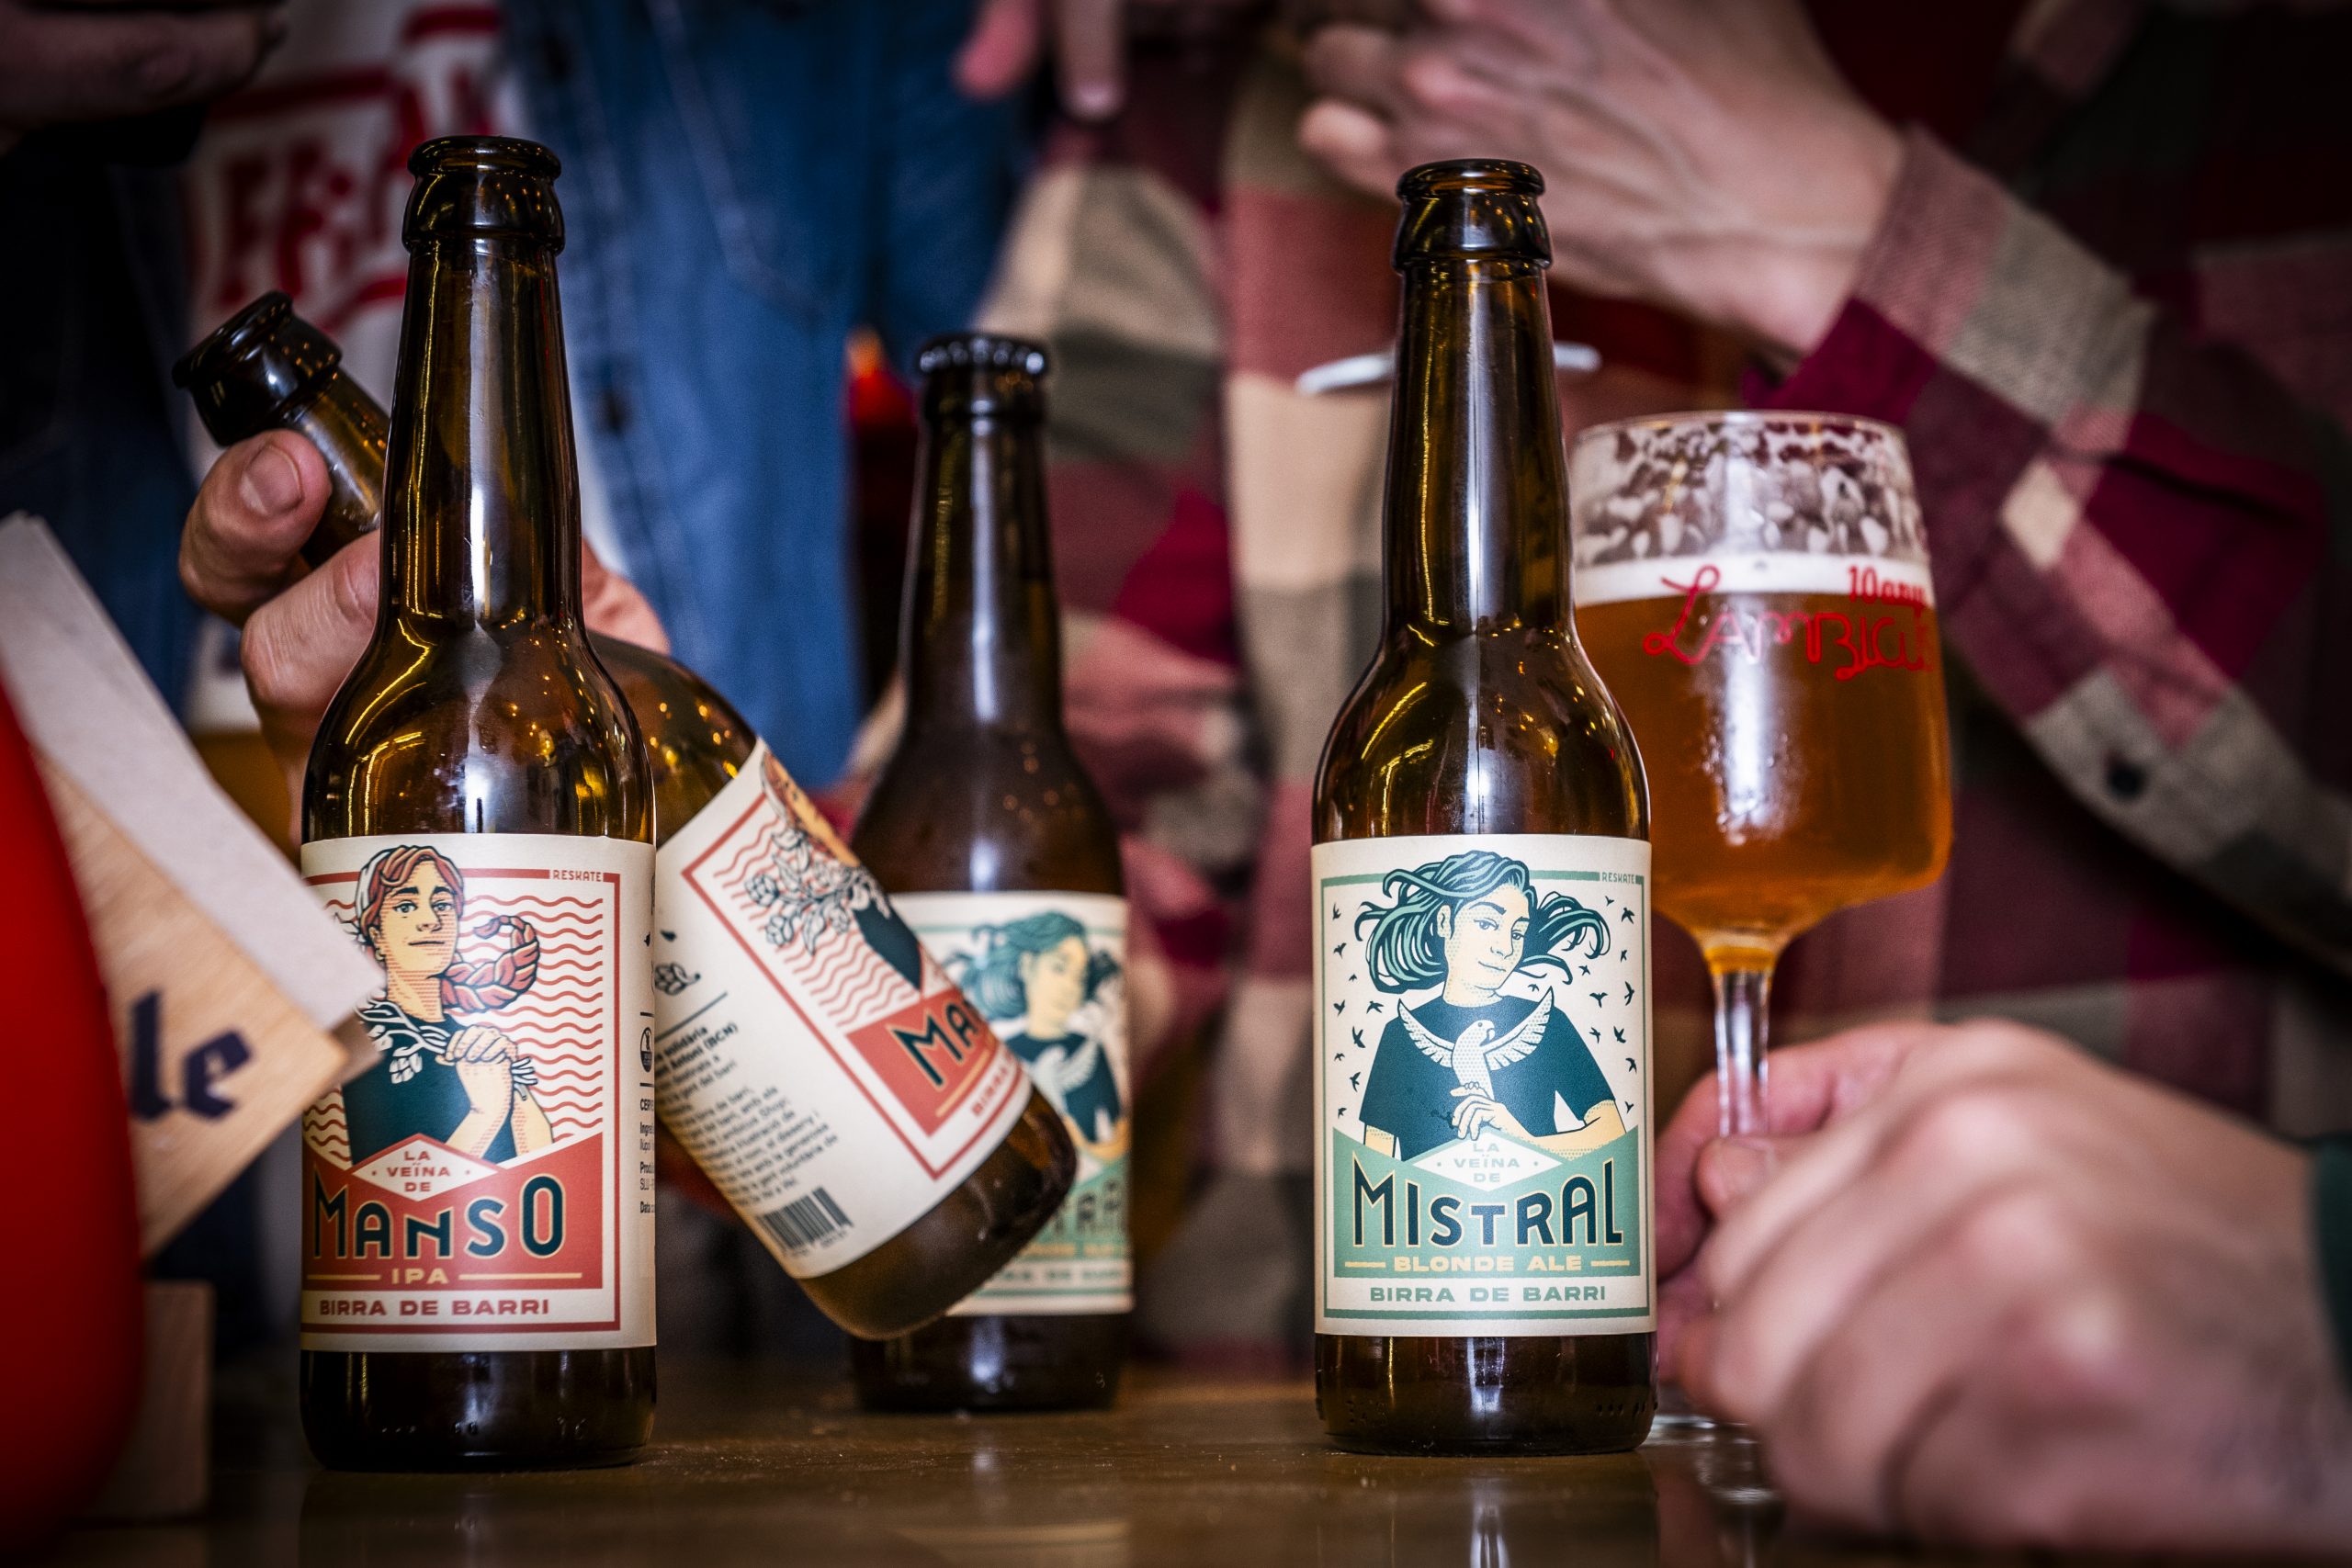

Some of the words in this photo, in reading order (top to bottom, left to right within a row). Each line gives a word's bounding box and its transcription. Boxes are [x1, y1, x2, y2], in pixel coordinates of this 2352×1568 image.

[553, 869, 602, 882] RESKATE
[1601, 872, 1636, 885] RESKATE
[1473, 1143, 1500, 1153] LA
[404, 1150, 431, 1161] LA
[1454, 1154, 1521, 1168] VEÏNA
[387, 1162, 450, 1177] VEÏNA
[1474, 1173, 1500, 1183] DE
[404, 1181, 431, 1192] DE
[1351, 1152, 1624, 1248] MISTRAL
[312, 1166, 566, 1259] MANSO
[1394, 1256, 1514, 1272] BLONDE
[1527, 1256, 1582, 1271] ALE
[391, 1268, 449, 1285] IPA
[1370, 1286, 1455, 1302] BIRRA
[1470, 1286, 1510, 1302] DE
[1522, 1286, 1605, 1301] BARRI
[320, 1299, 386, 1316] BIRRA
[399, 1300, 438, 1315] DE
[451, 1299, 549, 1315] BARRI
